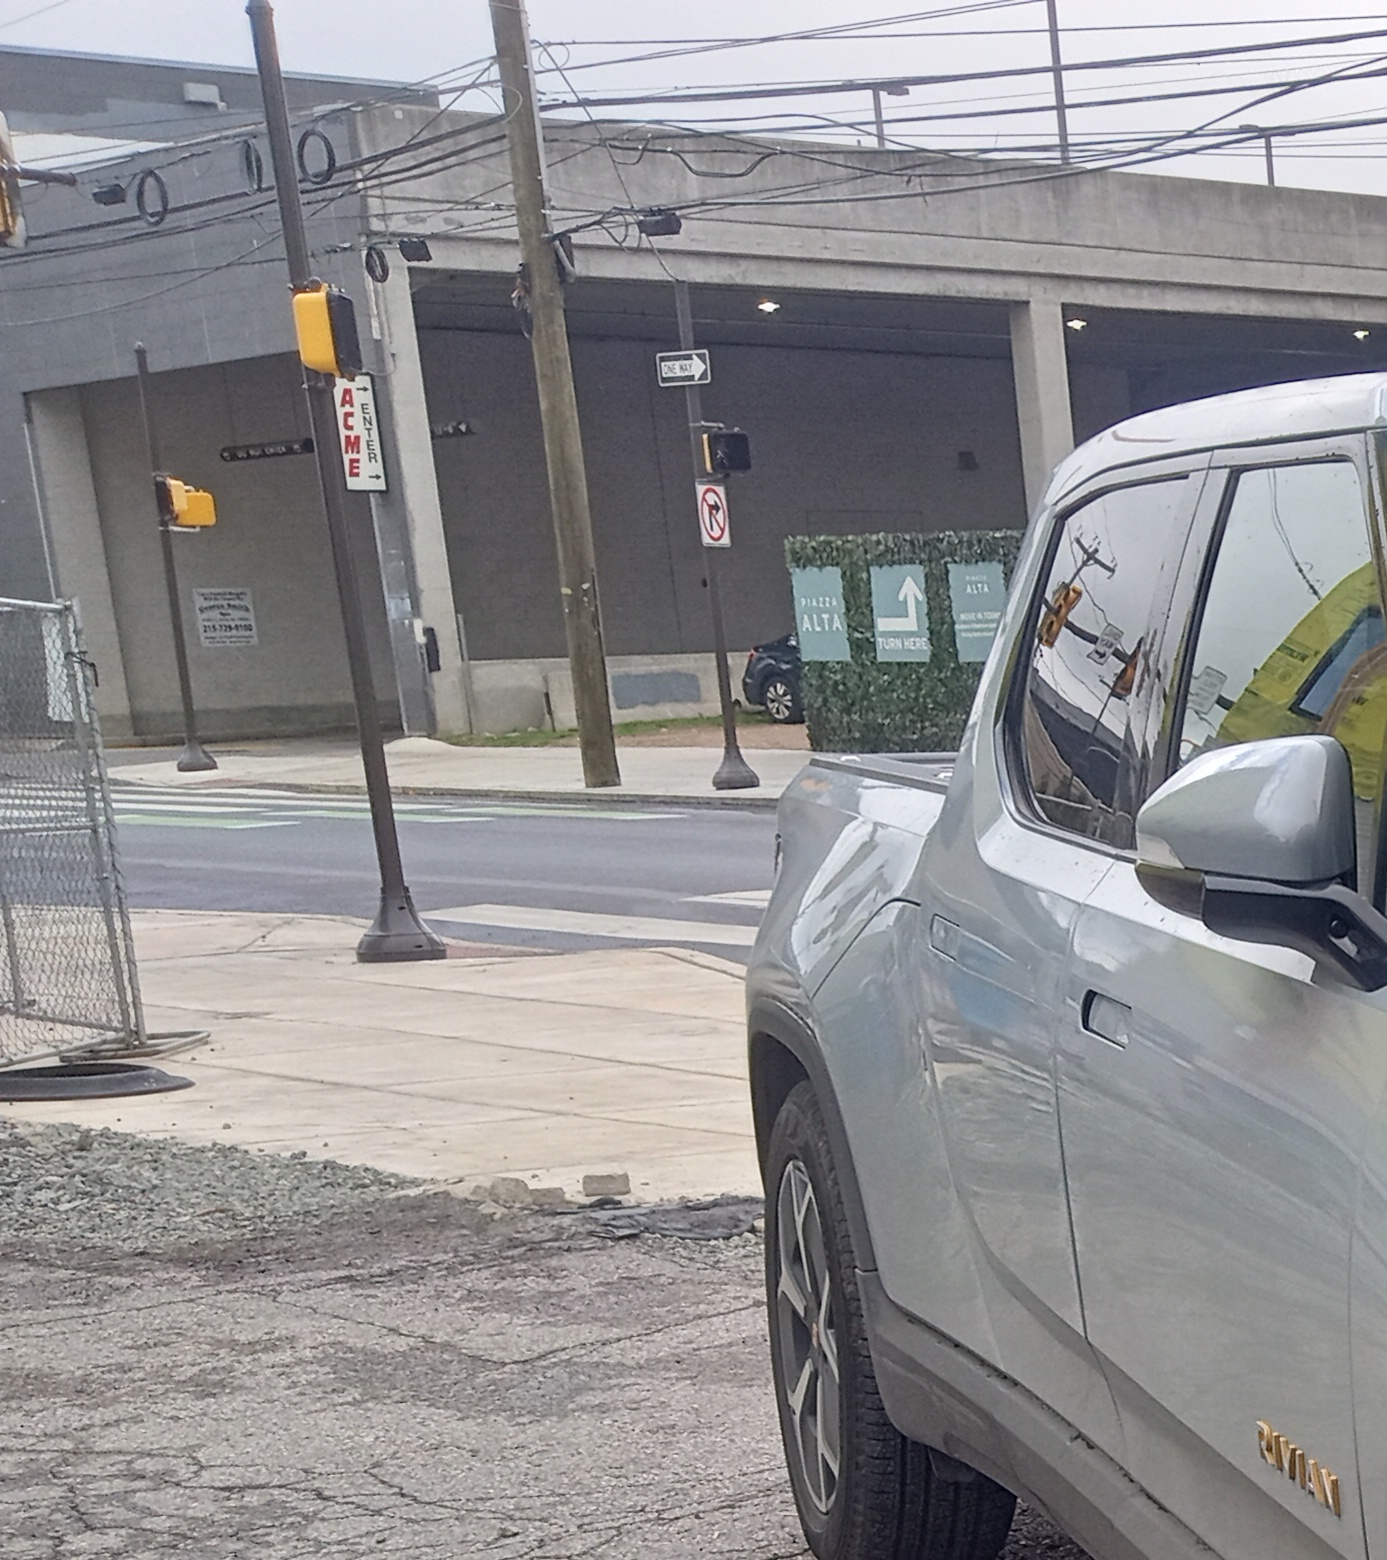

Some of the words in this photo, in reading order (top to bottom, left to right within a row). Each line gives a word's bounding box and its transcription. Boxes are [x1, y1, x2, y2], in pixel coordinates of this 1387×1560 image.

[663, 363, 678, 375] ONE
[679, 361, 693, 374] WAY
[340, 387, 361, 478] ACME
[360, 403, 378, 464] ENTER
[965, 583, 990, 595] ALTA
[801, 596, 839, 608] PIAZZA
[802, 613, 843, 632] ALTA
[877, 637, 902, 650] TURN
[903, 637, 928, 650] HERE
[1256, 1418, 1342, 1518] RIVIAN
